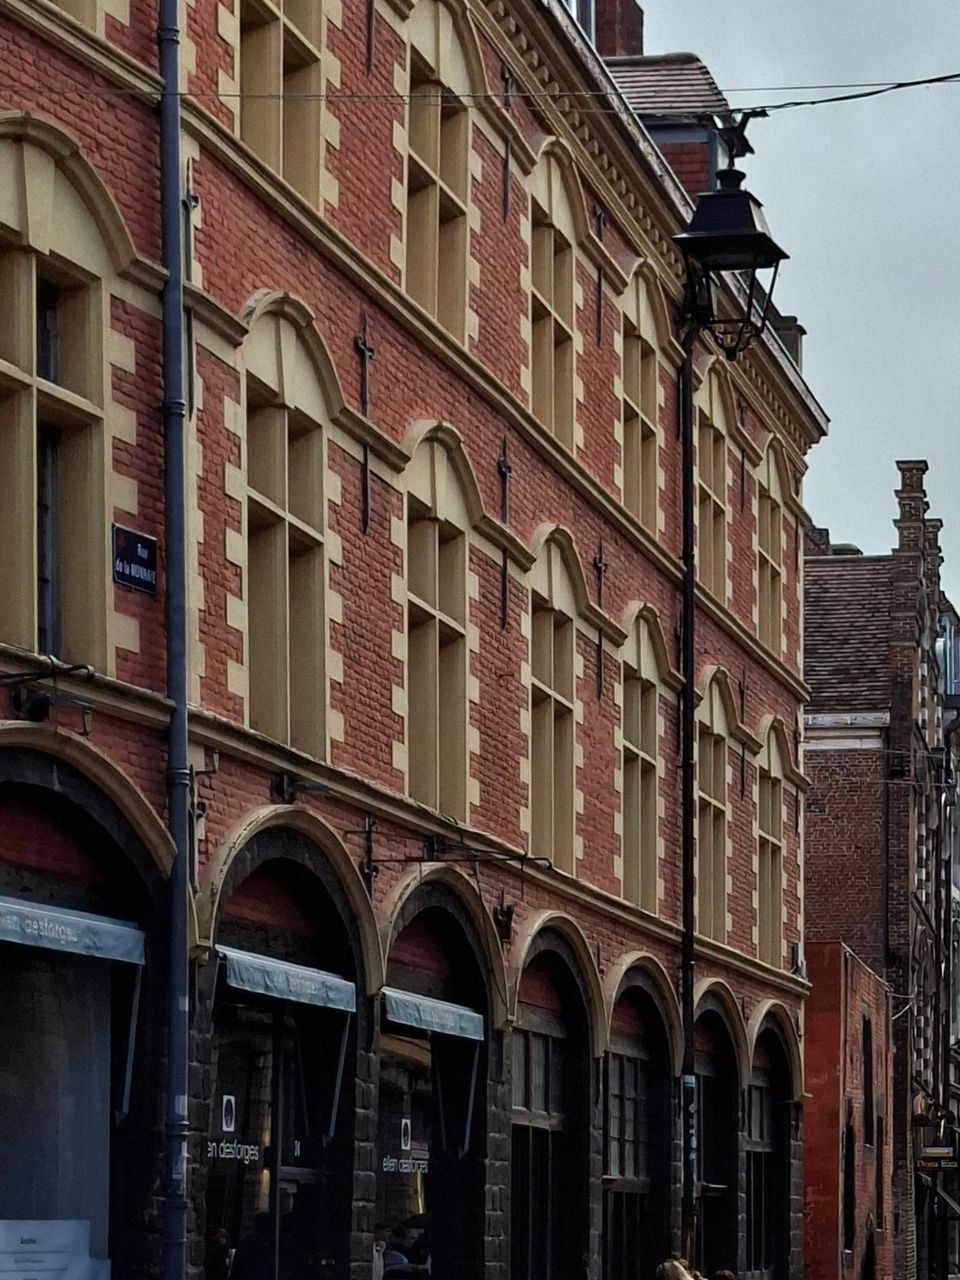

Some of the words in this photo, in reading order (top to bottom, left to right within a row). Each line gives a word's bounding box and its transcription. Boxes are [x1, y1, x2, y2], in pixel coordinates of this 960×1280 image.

[137, 543, 149, 559] Rue
[115, 558, 123, 573] de
[123, 560, 130, 575] la
[130, 563, 156, 585] MONNAIE
[219, 1138, 260, 1165] desforges
